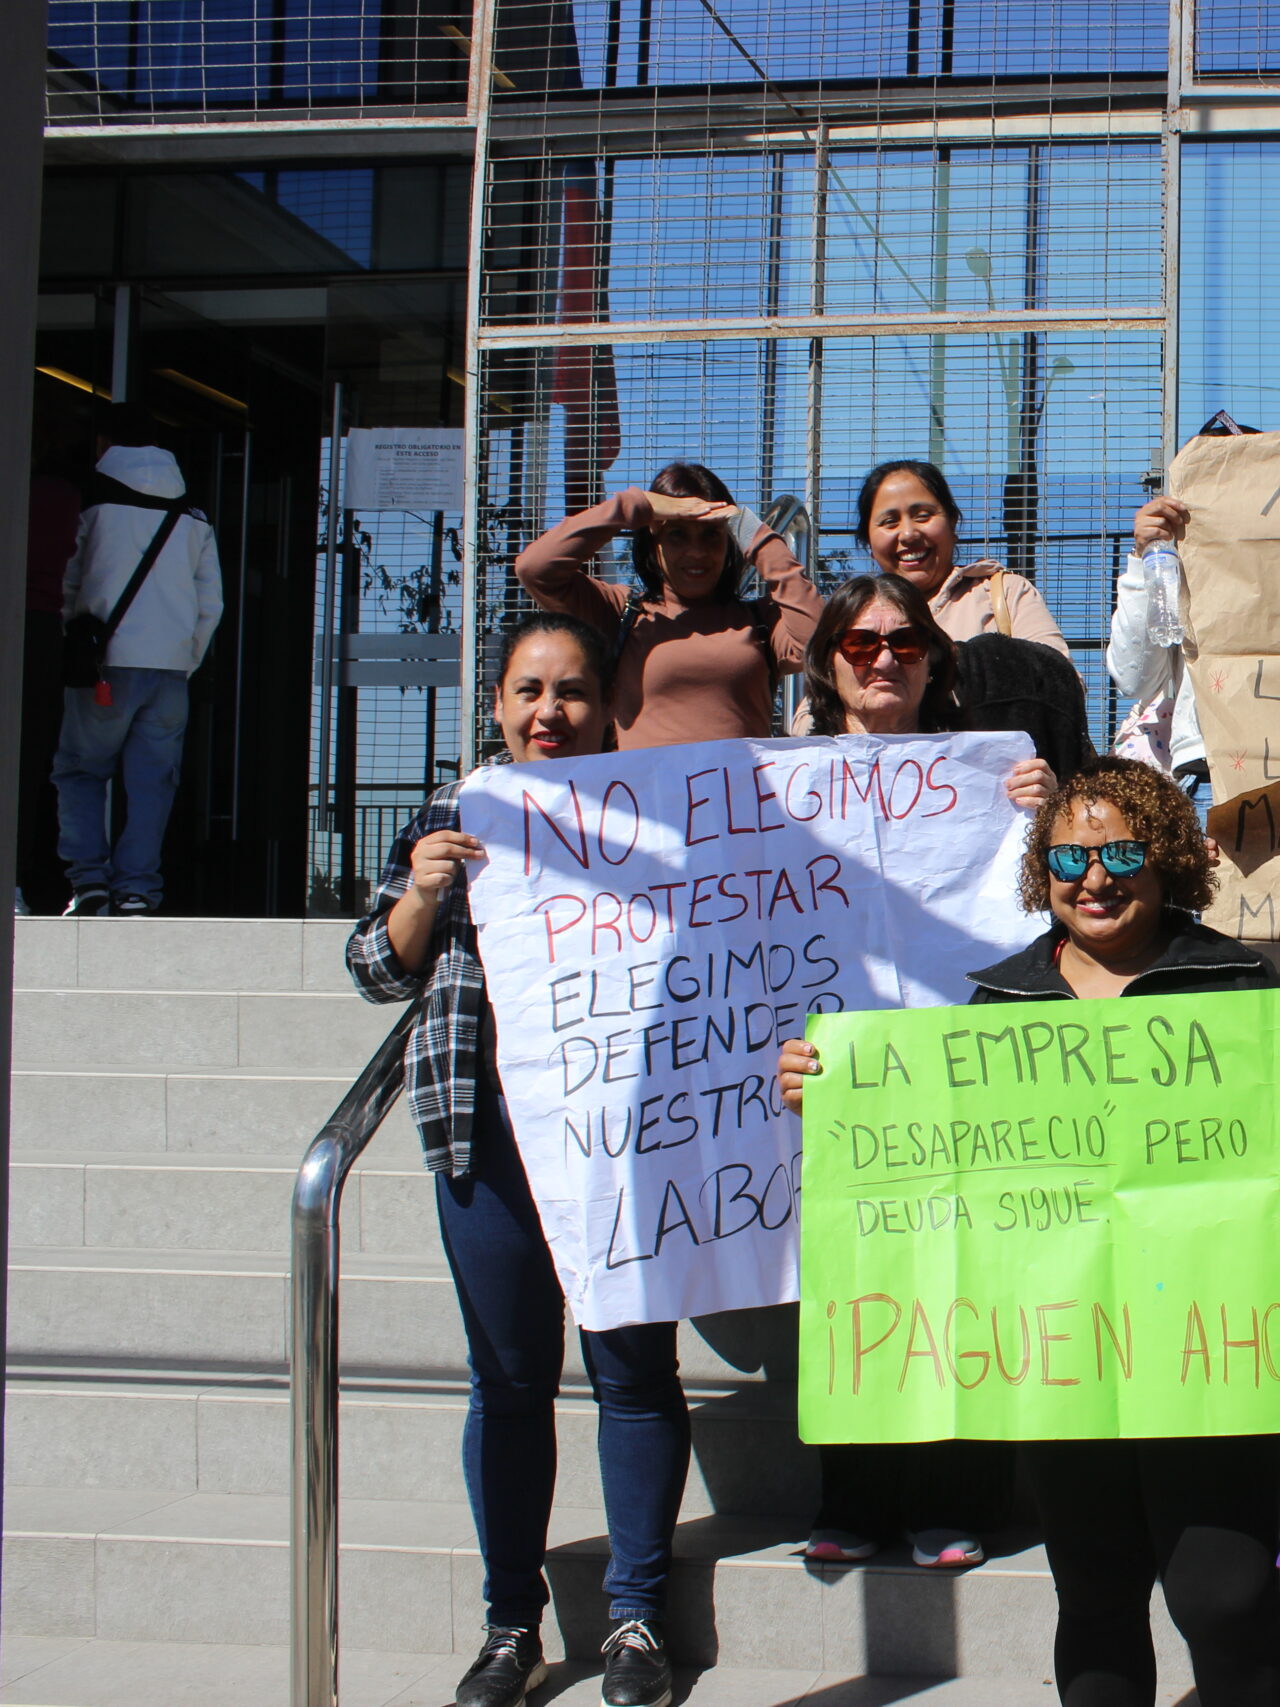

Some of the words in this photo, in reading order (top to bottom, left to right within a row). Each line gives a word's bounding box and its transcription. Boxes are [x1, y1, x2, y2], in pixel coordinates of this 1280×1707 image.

[521, 779, 641, 876] NO
[684, 755, 959, 847] ELEGIMOS
[534, 854, 851, 963] PROTESTAR
[550, 934, 841, 1033] ELEGIMOS
[849, 1039, 913, 1090] LA
[941, 1014, 1223, 1089] EMPRESA
[1144, 1116, 1249, 1166] PERO
[855, 1193, 973, 1237] DEUDA
[826, 1293, 1135, 1397] ¡PAGUEN
